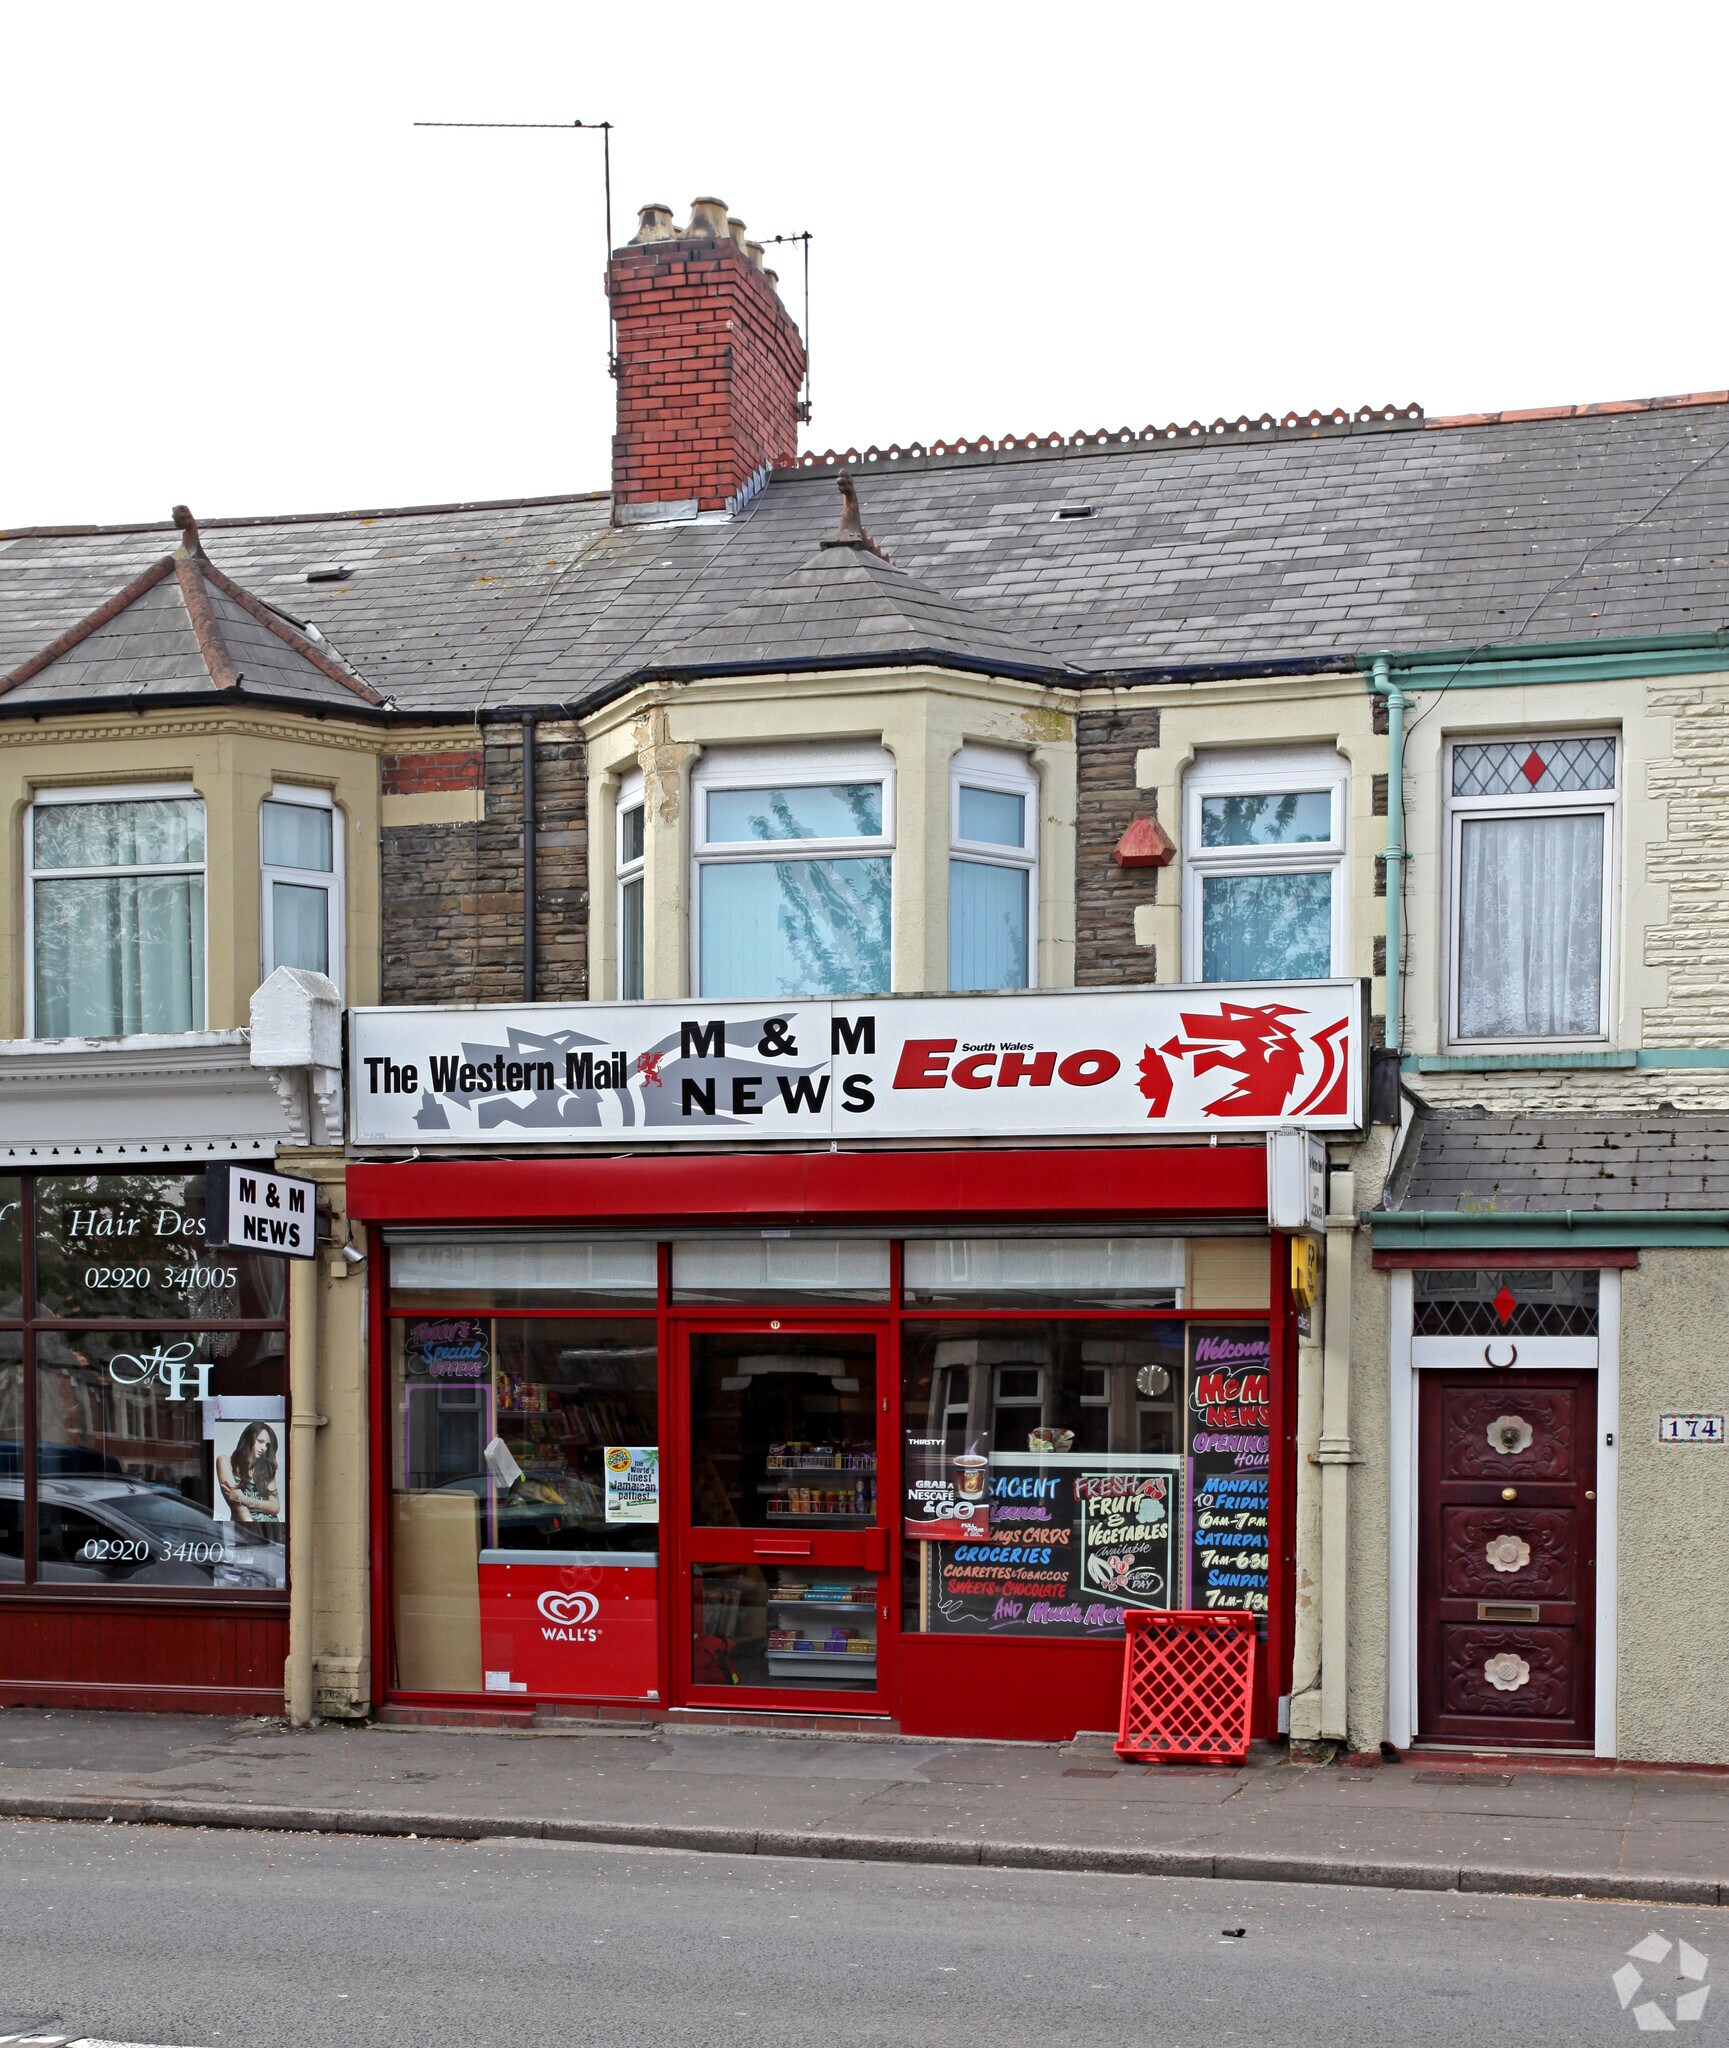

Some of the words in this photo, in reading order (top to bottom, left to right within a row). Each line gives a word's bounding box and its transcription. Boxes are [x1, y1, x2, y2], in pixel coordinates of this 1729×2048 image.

[681, 1020, 725, 1058] M
[758, 1018, 798, 1057] &
[832, 1016, 875, 1055] M
[962, 1043, 995, 1052] South
[1000, 1042, 1034, 1051] Wales
[364, 1056, 418, 1094] The
[430, 1055, 554, 1093] Western
[565, 1051, 628, 1090] Mail
[892, 1039, 1121, 1090] ECHO
[682, 1074, 875, 1116] NEWS
[240, 1177, 256, 1204] M
[266, 1182, 280, 1209] &
[289, 1187, 304, 1213] M
[70, 1209, 140, 1237] Hair
[155, 1209, 206, 1237] Des
[244, 1214, 300, 1248] NEWS
[85, 1268, 150, 1288] 02920
[161, 1267, 238, 1289] 341005
[421, 1338, 482, 1365] Special
[429, 1358, 483, 1377] OFFERS
[165, 1363, 214, 1401] H
[1206, 1405, 1270, 1428] NEWS
[1669, 1420, 1717, 1437] 174
[908, 1438, 946, 1446] THIRSTY?
[1193, 1432, 1270, 1453] OPENING
[627, 1473, 652, 1482] finest
[630, 1466, 656, 1474] World's
[611, 1481, 656, 1492] Jamaican
[915, 1480, 946, 1489] GRAB
[988, 1476, 1061, 1499] SAGENT
[1074, 1475, 1138, 1500] FRESH
[618, 1491, 650, 1501] patties!
[1088, 1494, 1145, 1517] FRUIT
[1194, 1493, 1214, 1507] TO
[989, 1500, 1052, 1522] icence
[1022, 1527, 1071, 1545] CARDS
[1087, 1522, 1168, 1546] VEGETABLES
[1194, 1529, 1269, 1548] SATURDAY
[84, 1539, 149, 1560] 02920
[954, 1544, 1052, 1565] GROCERIES
[943, 1564, 1012, 1580] CIGARETTES
[1017, 1567, 1069, 1582] TOBACCOS
[1128, 1572, 1150, 1581] EVERY
[947, 1579, 996, 1596] SWEETS
[1001, 1580, 1067, 1598] CHOCOLATE
[1131, 1579, 1154, 1590] DAY
[991, 1597, 1024, 1621] AND
[1027, 1601, 1084, 1625] Much
[1084, 1603, 1125, 1627] Mor
[541, 1628, 597, 1642] WALL'S
